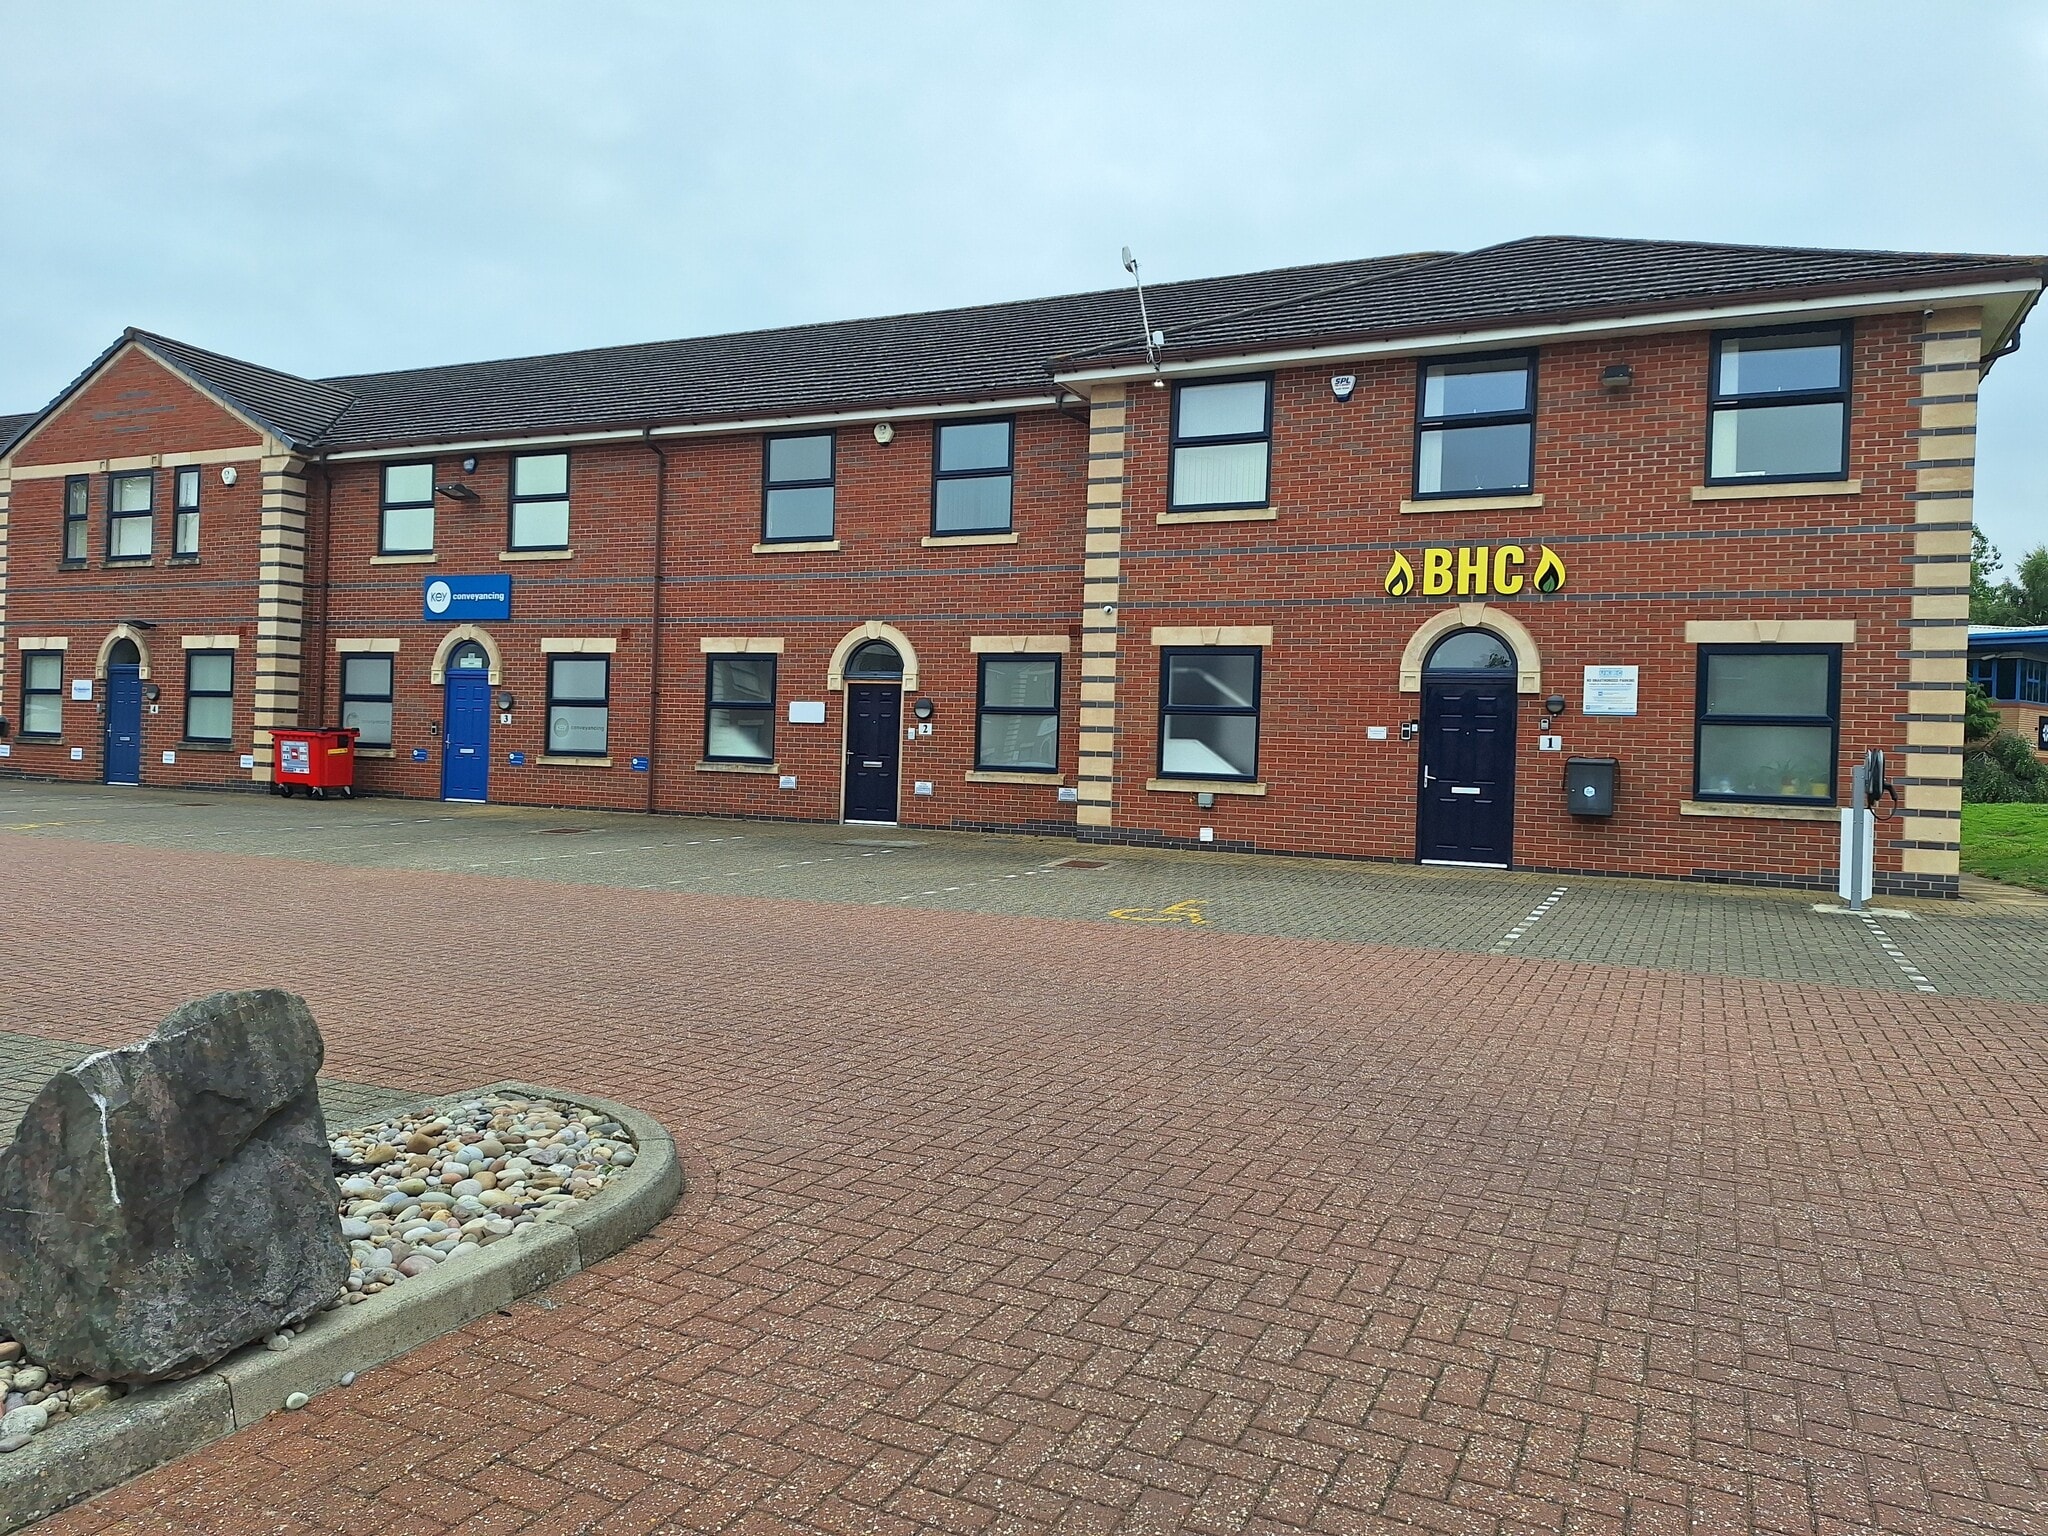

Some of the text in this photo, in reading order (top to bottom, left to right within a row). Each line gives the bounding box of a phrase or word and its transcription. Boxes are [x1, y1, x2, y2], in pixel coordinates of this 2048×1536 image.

[1335, 377, 1351, 385] SPL
[1422, 545, 1525, 596] BHC
[452, 592, 505, 602] conveyancing
[151, 705, 157, 713] 4
[503, 714, 509, 723] 3
[922, 724, 929, 733] 2
[1546, 737, 1554, 748] 1
